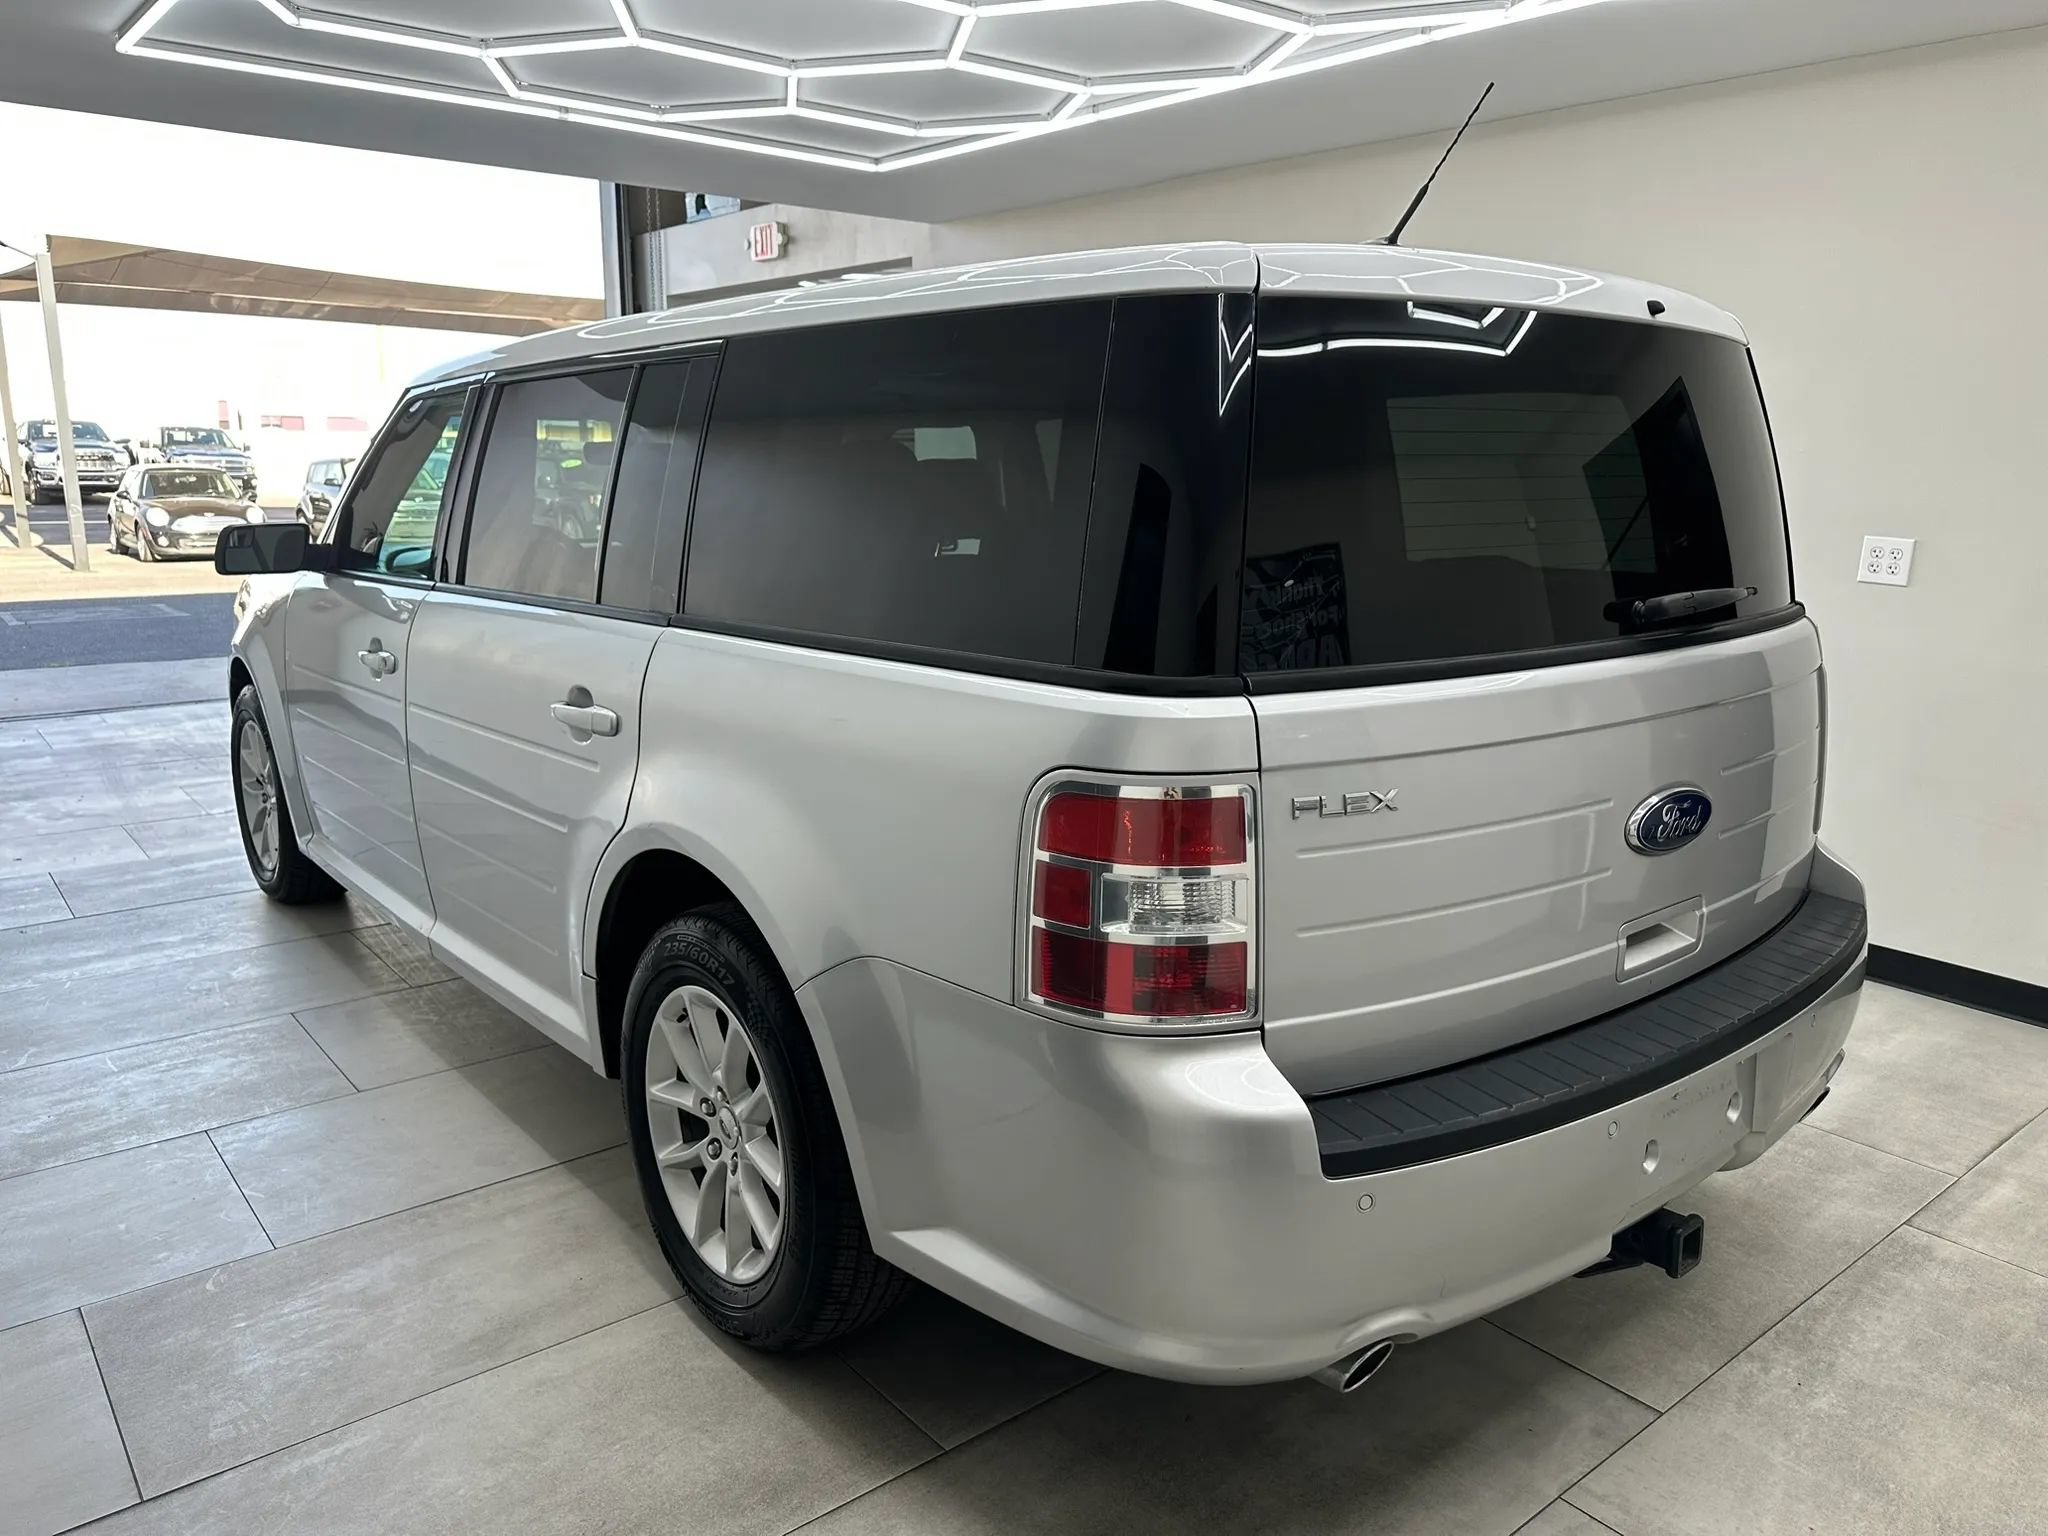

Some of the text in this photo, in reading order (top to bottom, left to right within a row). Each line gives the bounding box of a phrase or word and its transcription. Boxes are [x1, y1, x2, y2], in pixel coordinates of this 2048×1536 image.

[754, 223, 774, 258] EXIT
[1291, 788, 1399, 820] FLEX
[1656, 799, 1703, 842] Ford
[663, 941, 735, 985] 235/60R17
